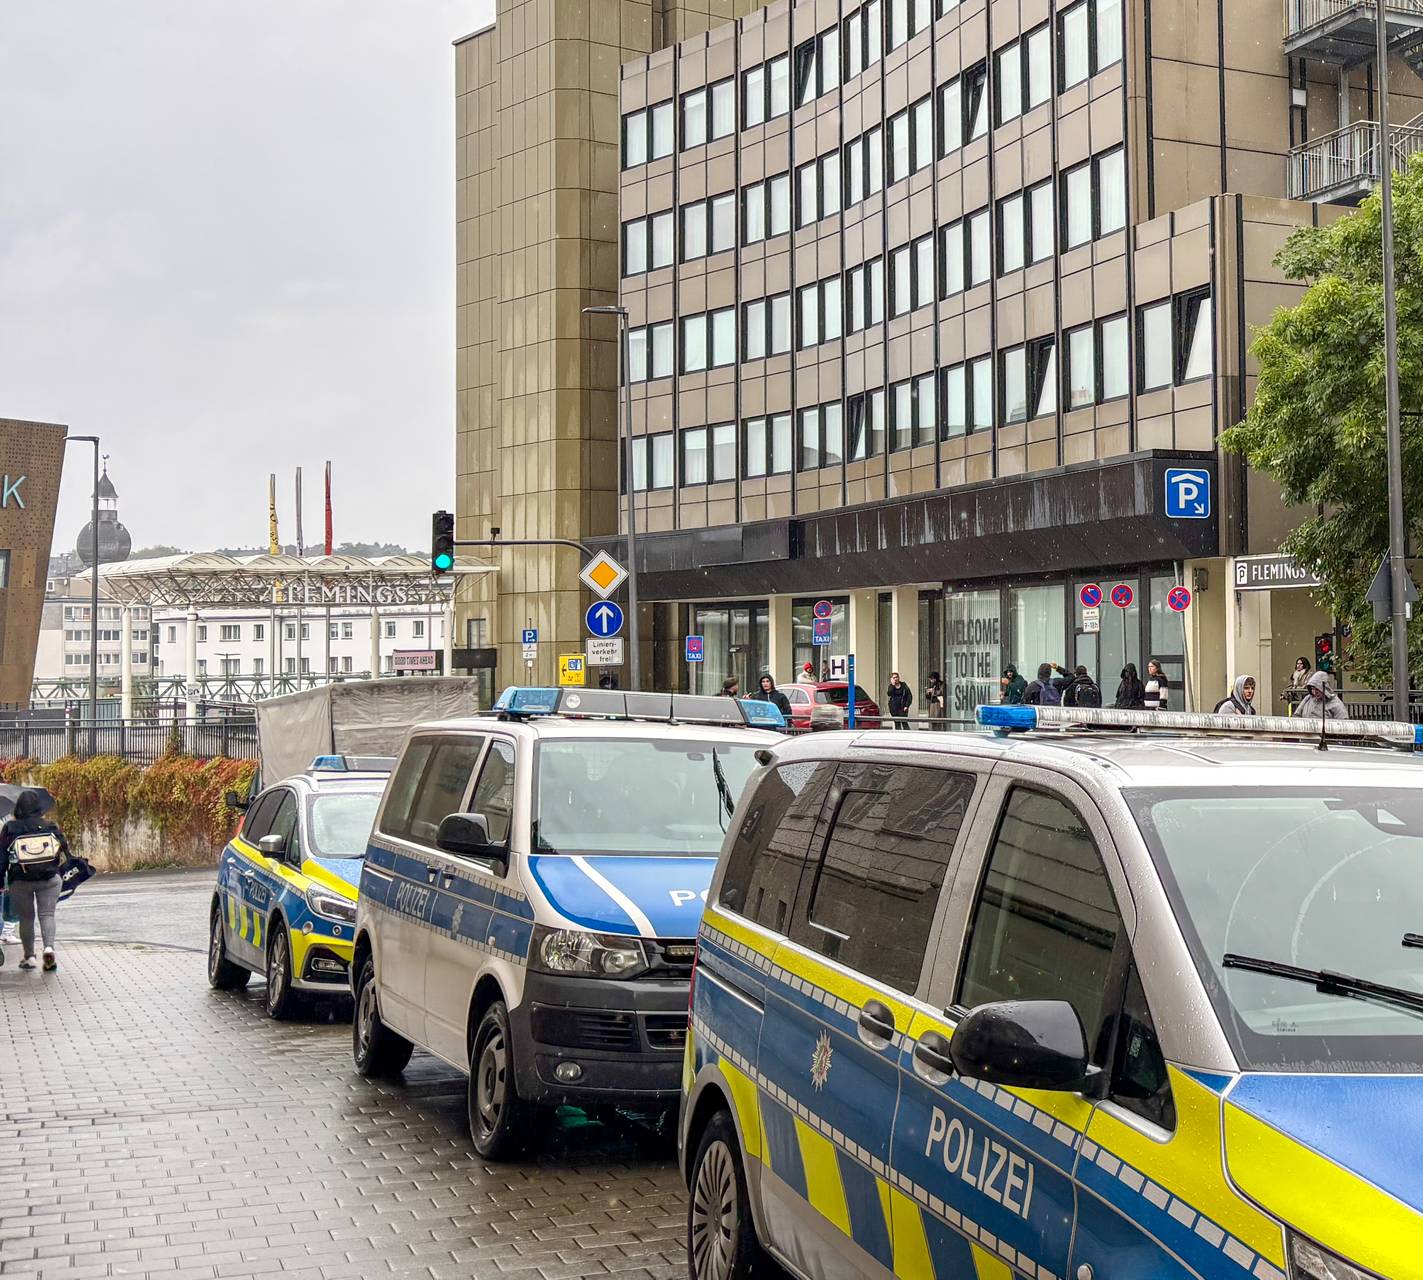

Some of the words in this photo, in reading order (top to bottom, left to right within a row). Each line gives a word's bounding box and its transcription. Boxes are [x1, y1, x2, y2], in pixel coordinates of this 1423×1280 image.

[3, 474, 28, 508] K
[947, 617, 999, 646] WELCOME
[831, 658, 845, 675] H
[954, 652, 967, 678] TO
[970, 651, 991, 678] THE
[395, 881, 430, 918] POLIZEI
[925, 1105, 1035, 1221] POLIZEI
